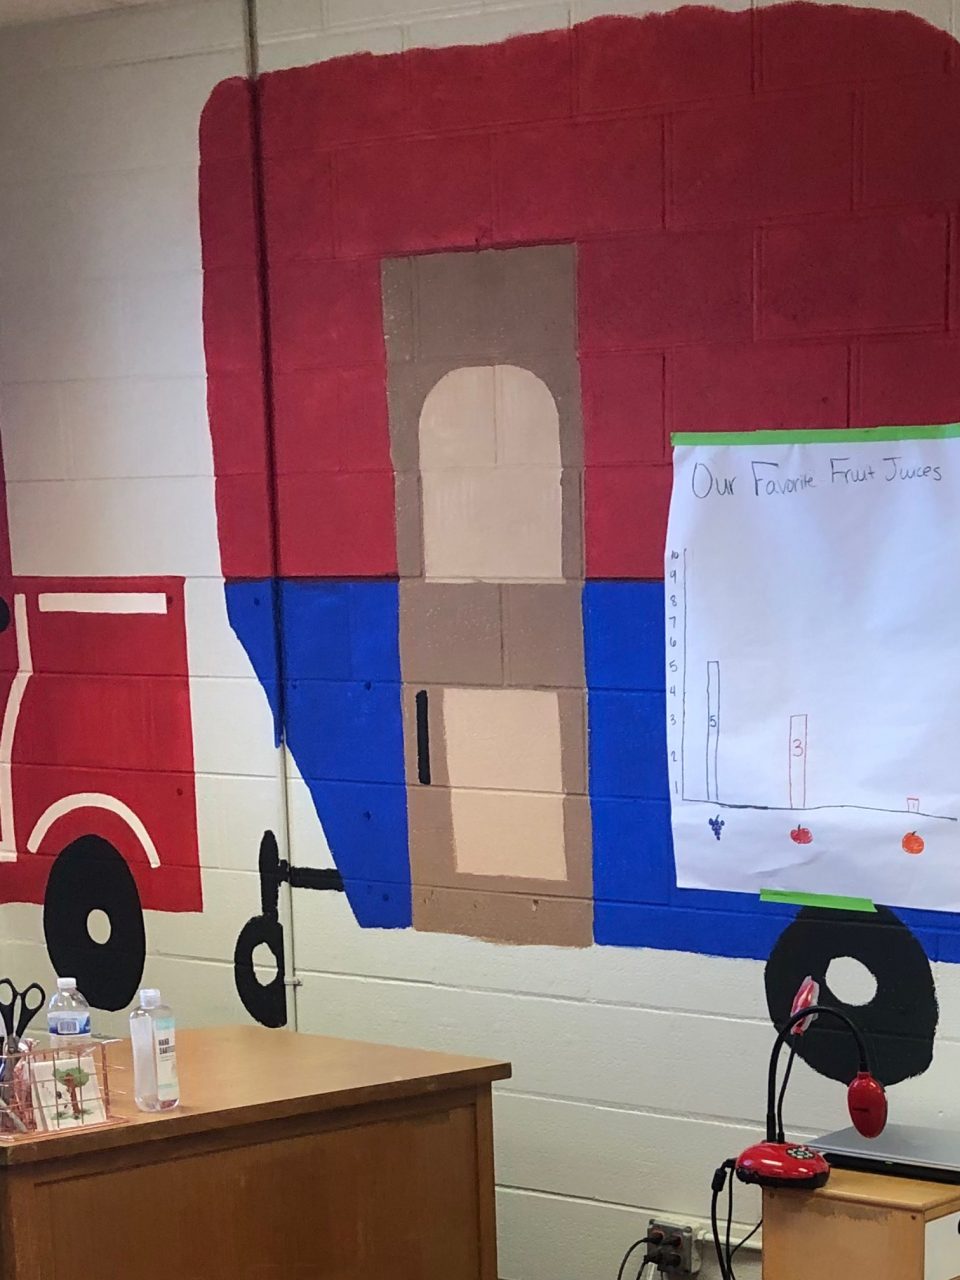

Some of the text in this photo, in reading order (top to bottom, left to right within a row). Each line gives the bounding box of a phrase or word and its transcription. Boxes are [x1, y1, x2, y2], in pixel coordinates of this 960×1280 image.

[692, 456, 943, 499] Our Favorite Fruit Juices
[670, 550, 680, 560] 10
[669, 569, 677, 584] 9
[669, 594, 678, 607] 8
[668, 616, 677, 629] 7
[669, 636, 677, 648] 6
[669, 659, 678, 673] 5
[669, 684, 676, 697] 4
[670, 713, 677, 726] 3
[709, 714, 717, 728] 5
[792, 738, 804, 757] 3
[670, 750, 678, 762] 2
